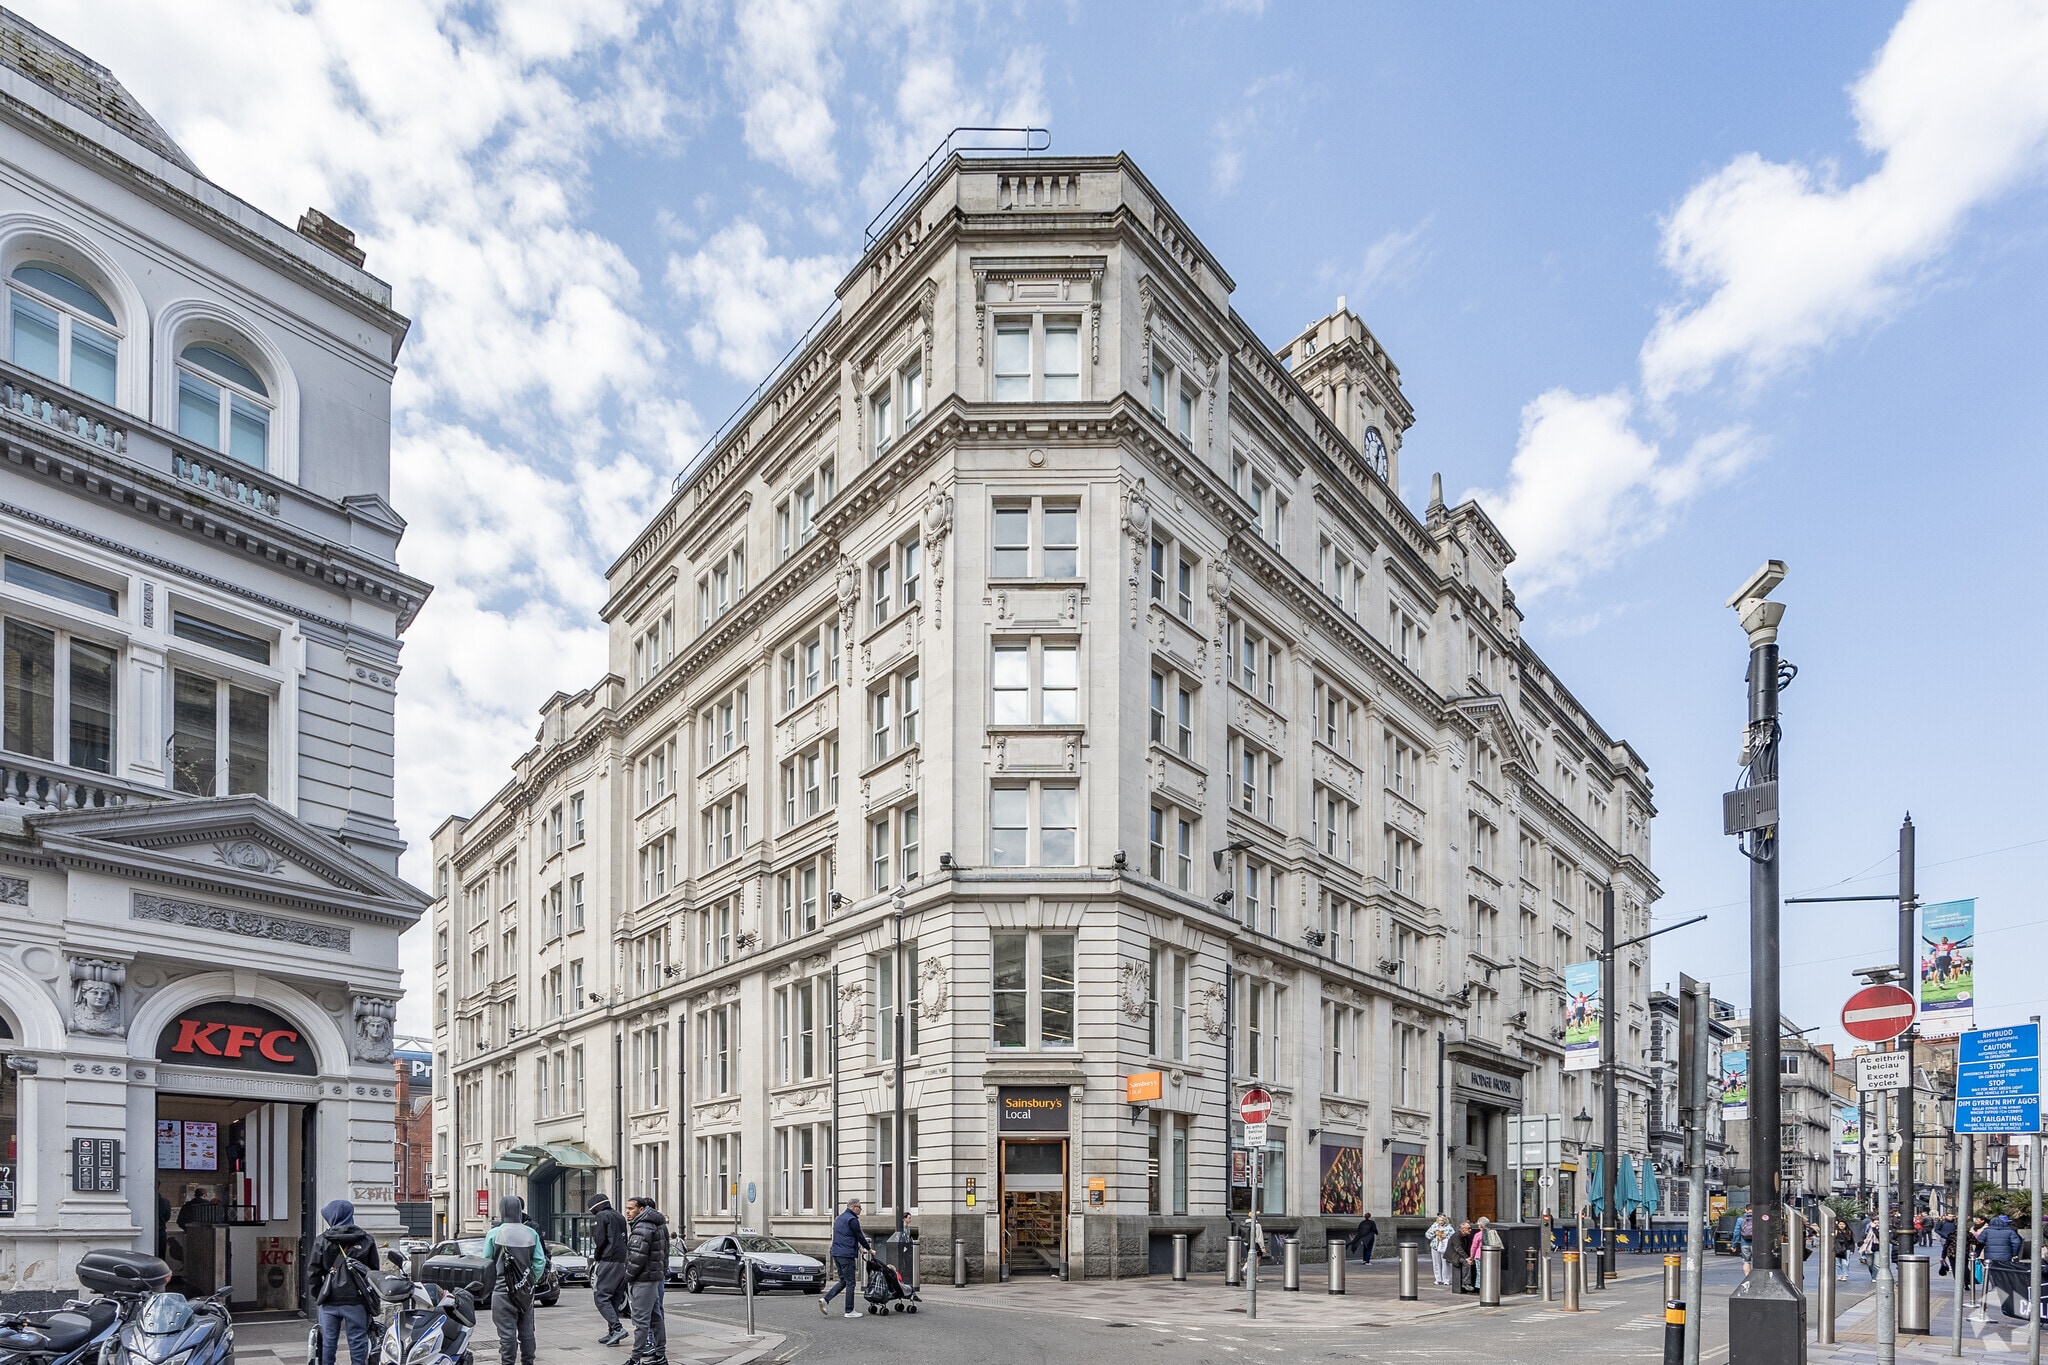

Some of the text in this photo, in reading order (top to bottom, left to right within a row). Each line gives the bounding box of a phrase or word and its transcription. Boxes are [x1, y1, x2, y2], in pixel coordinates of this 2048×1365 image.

[1982, 1029, 2013, 1038] RHYBUDD
[171, 1019, 298, 1062] KFC
[1983, 1042, 2012, 1051] CAUTION
[1874, 1054, 1906, 1062] eithrio
[1866, 1062, 1899, 1070] beiciau
[1867, 1072, 1899, 1081] Except
[1493, 1076, 1512, 1093] HOUSE
[1868, 1080, 1898, 1088] cycles
[1006, 1098, 1062, 1110] Sainsbury's
[1006, 1110, 1031, 1119] Local
[260, 1250, 294, 1265] KFC
